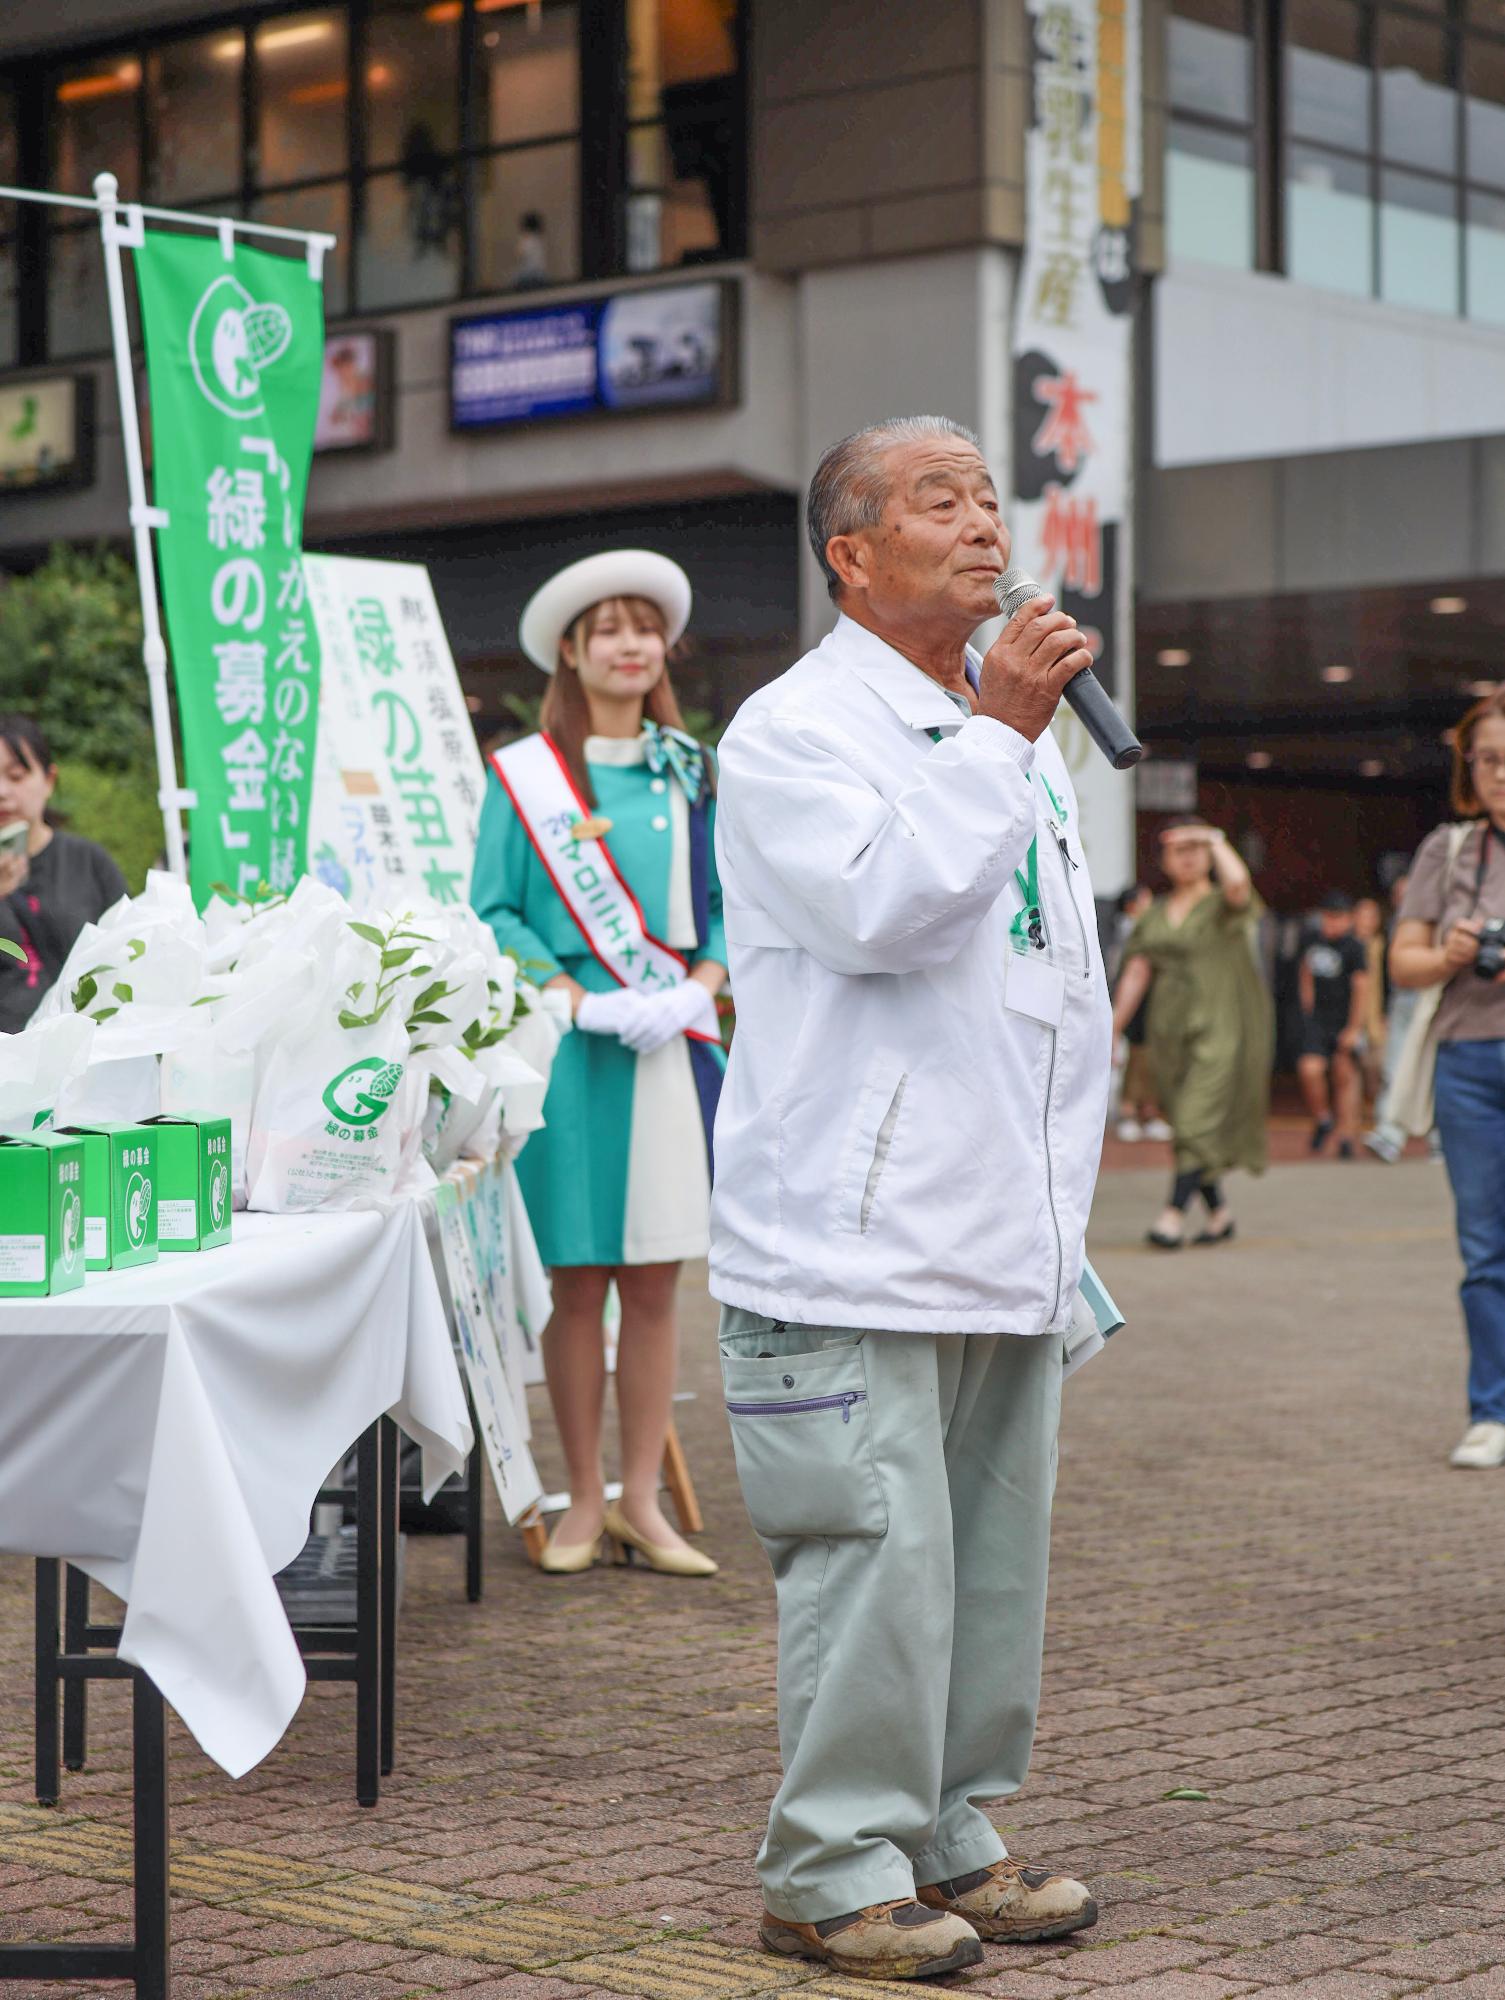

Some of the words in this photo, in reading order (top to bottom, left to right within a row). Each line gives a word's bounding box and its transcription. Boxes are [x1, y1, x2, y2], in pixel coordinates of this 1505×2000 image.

[347, 596, 466, 918] 緑の苗木
[324, 1120, 379, 1143] 緑の募金
[122, 1146, 150, 1169] 緑の募金
[207, 1135, 227, 1157] 緑の募金
[58, 1160, 80, 1185] 緑の募金
